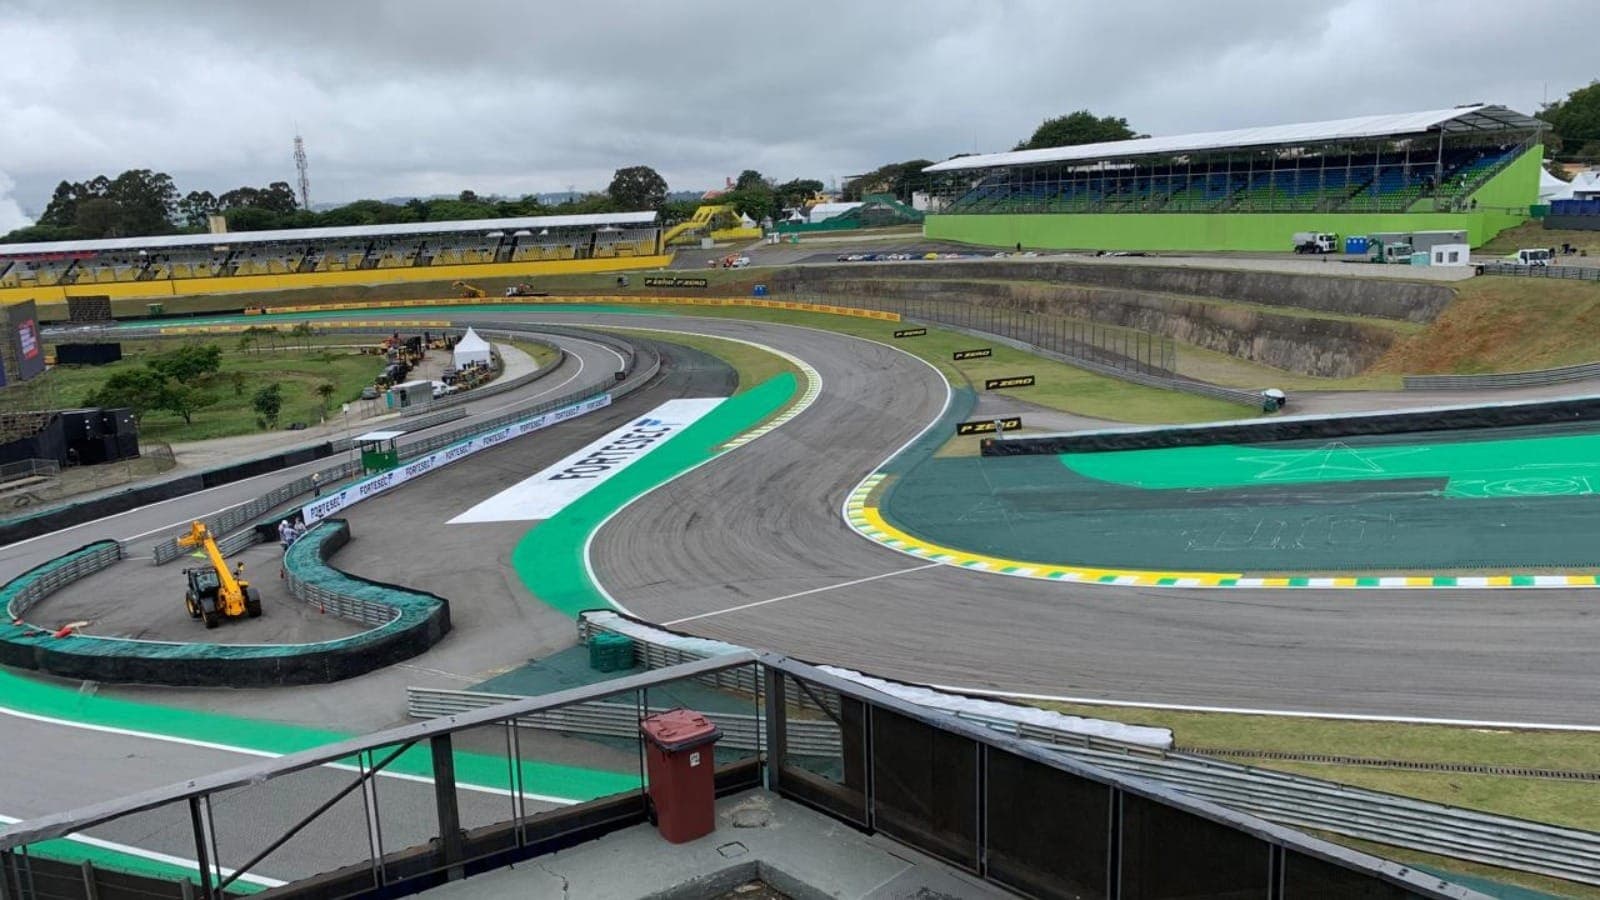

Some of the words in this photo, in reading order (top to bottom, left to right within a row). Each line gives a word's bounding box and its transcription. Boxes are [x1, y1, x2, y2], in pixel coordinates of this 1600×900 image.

[999, 378, 1033, 386] ZERO
[961, 425, 972, 433] P
[974, 420, 1018, 431] ZEO
[548, 427, 671, 481] FORTESEC
[405, 461, 431, 477] FORTESEC
[360, 478, 389, 496] FORTESEC
[310, 496, 341, 518] FORTESEC
